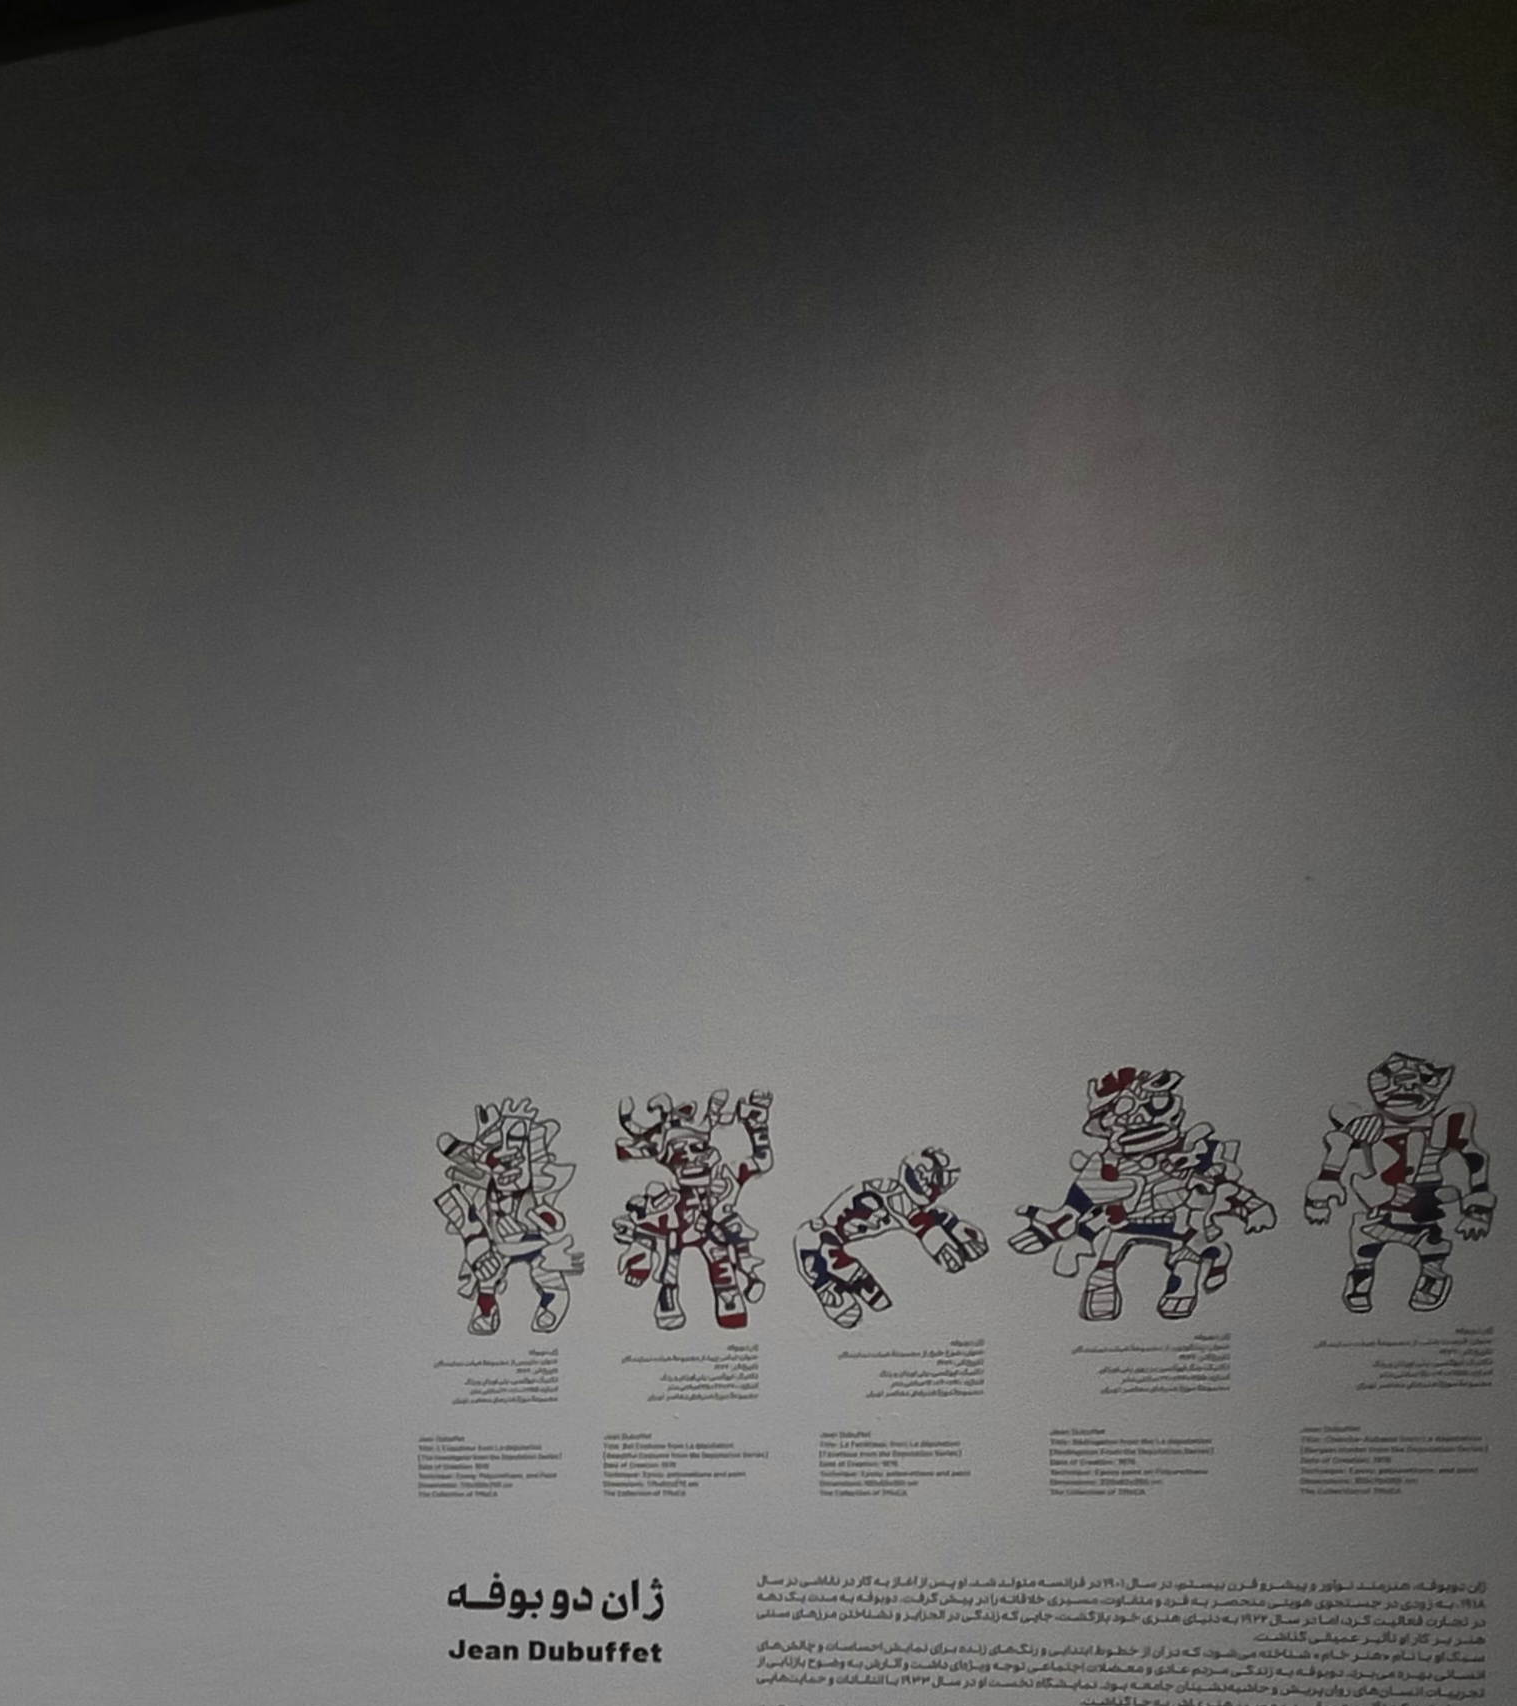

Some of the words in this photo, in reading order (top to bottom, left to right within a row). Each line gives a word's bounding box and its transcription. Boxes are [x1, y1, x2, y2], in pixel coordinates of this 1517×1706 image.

[601, 1576, 665, 1622] ژان
[448, 1639, 519, 1661] Jean
[528, 1640, 663, 1663] Dubuffet
